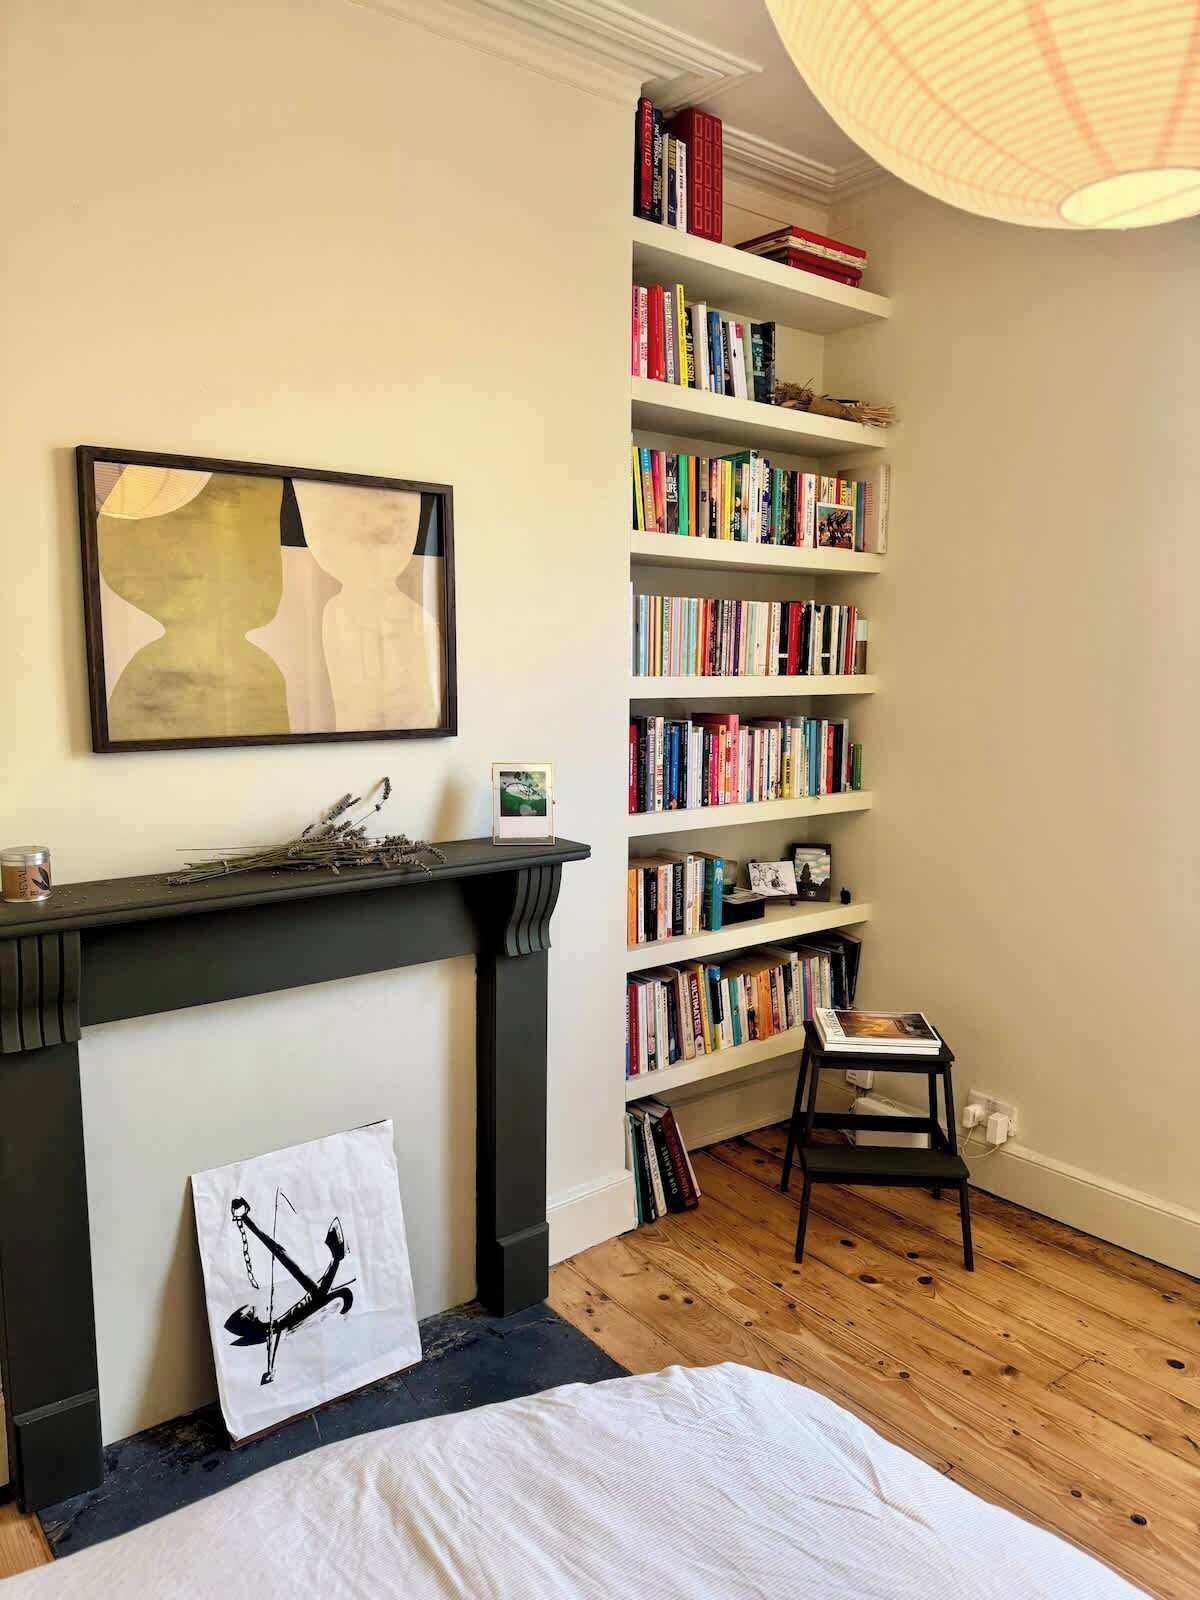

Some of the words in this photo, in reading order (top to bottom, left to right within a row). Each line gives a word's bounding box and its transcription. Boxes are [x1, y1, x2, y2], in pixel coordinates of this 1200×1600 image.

[644, 109, 652, 130] LEE
[644, 132, 652, 166] CHILD
[655, 779, 664, 796] SAID
[674, 865, 683, 892] Bernard
[674, 892, 683, 921] Cornwell
[690, 983, 701, 1026] ULTIMATE
